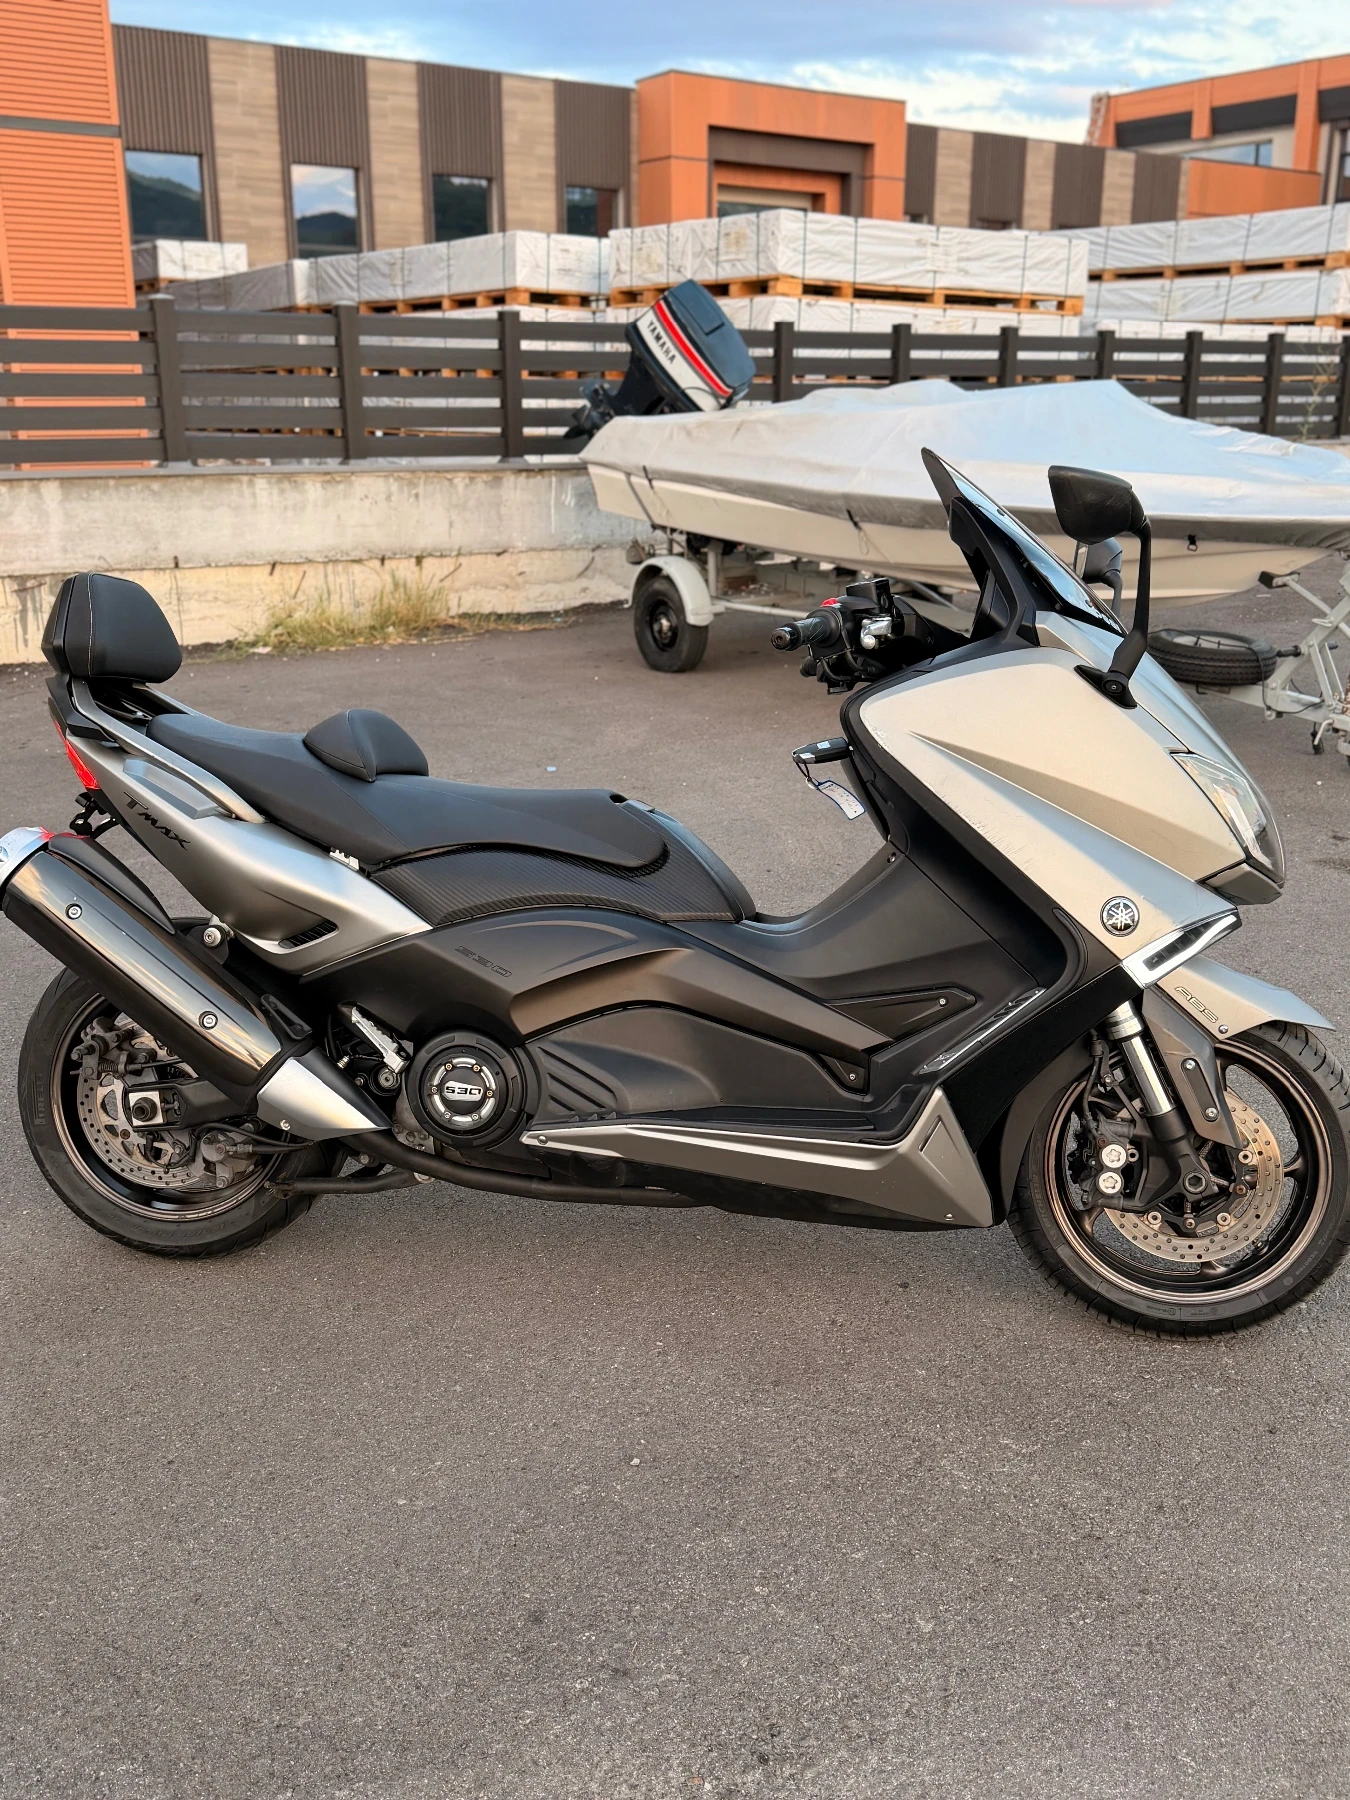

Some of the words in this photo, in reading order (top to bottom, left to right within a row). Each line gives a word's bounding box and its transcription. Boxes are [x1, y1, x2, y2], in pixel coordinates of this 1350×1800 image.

[646, 320, 677, 364] YAMAHA
[454, 945, 513, 978] 530
[1174, 985, 1219, 1024] ABS
[445, 1085, 482, 1096] 530
